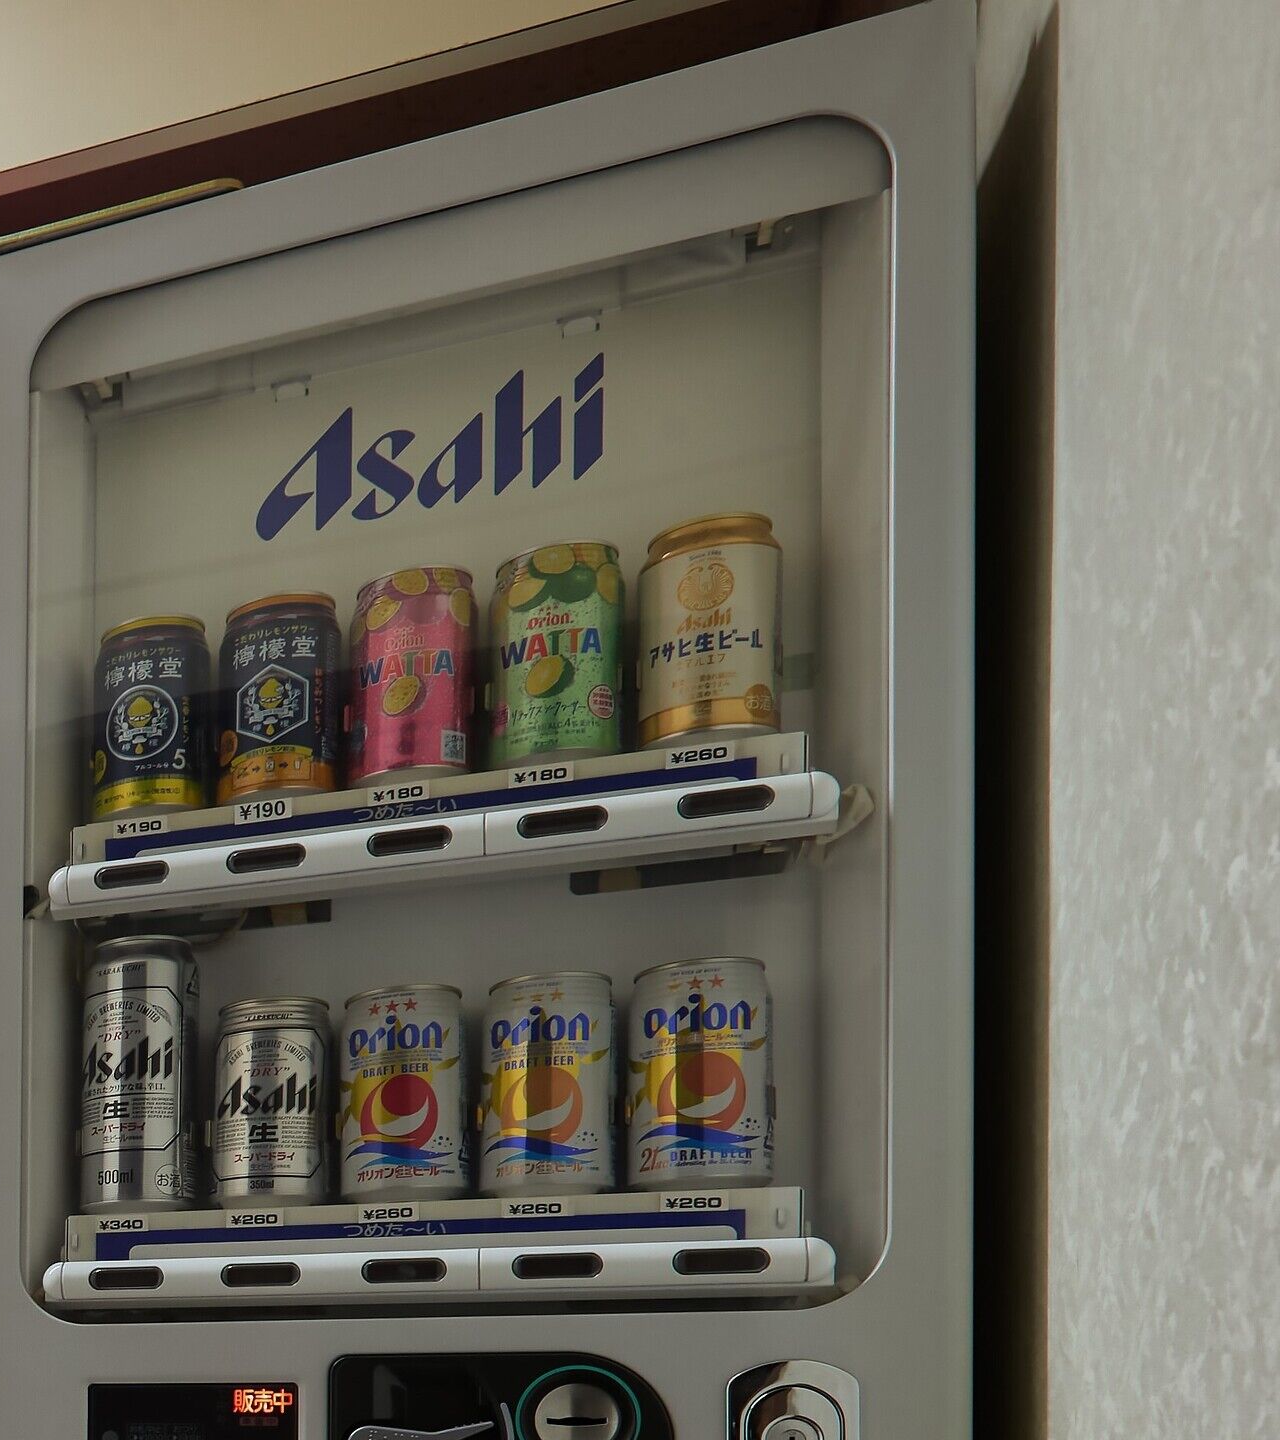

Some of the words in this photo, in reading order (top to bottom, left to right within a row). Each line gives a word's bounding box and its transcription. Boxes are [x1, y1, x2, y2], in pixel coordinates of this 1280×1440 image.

[255, 352, 606, 542] Asahi
[676, 607, 732, 636] Asahi
[234, 623, 315, 646] こだわりレモンサワー
[233, 635, 319, 669] 檸檬堂
[500, 626, 602, 670] WATTA
[650, 627, 764, 670] アサヒ生ビール
[104, 657, 184, 689] 檸檬堂
[359, 649, 454, 690] WATTA
[671, 746, 728, 764] ¥260
[514, 767, 568, 783] ¥180
[373, 785, 423, 802] ¥180
[239, 800, 286, 820] ¥190
[116, 820, 163, 834] ¥190
[83, 1035, 173, 1086] Asahi
[504, 1058, 538, 1072] DRAFT
[545, 1054, 574, 1067] BEER
[362, 1066, 397, 1079] DRAFT
[401, 1062, 429, 1074] BEER
[217, 1069, 318, 1118] Asahi
[102, 1100, 131, 1120] 生
[91, 1121, 146, 1136] スーパードライ
[249, 1122, 279, 1143] 生
[234, 1151, 295, 1164] スーパードライ
[98, 1168, 134, 1186] 500ml
[250, 1179, 274, 1190] 350ml
[509, 1202, 562, 1215] ¥260
[665, 1196, 723, 1210] ¥260
[231, 1213, 278, 1226] ¥260
[363, 1207, 413, 1220] ¥260
[99, 1219, 144, 1230] ¥340
[233, 1389, 293, 1414] 販売中
